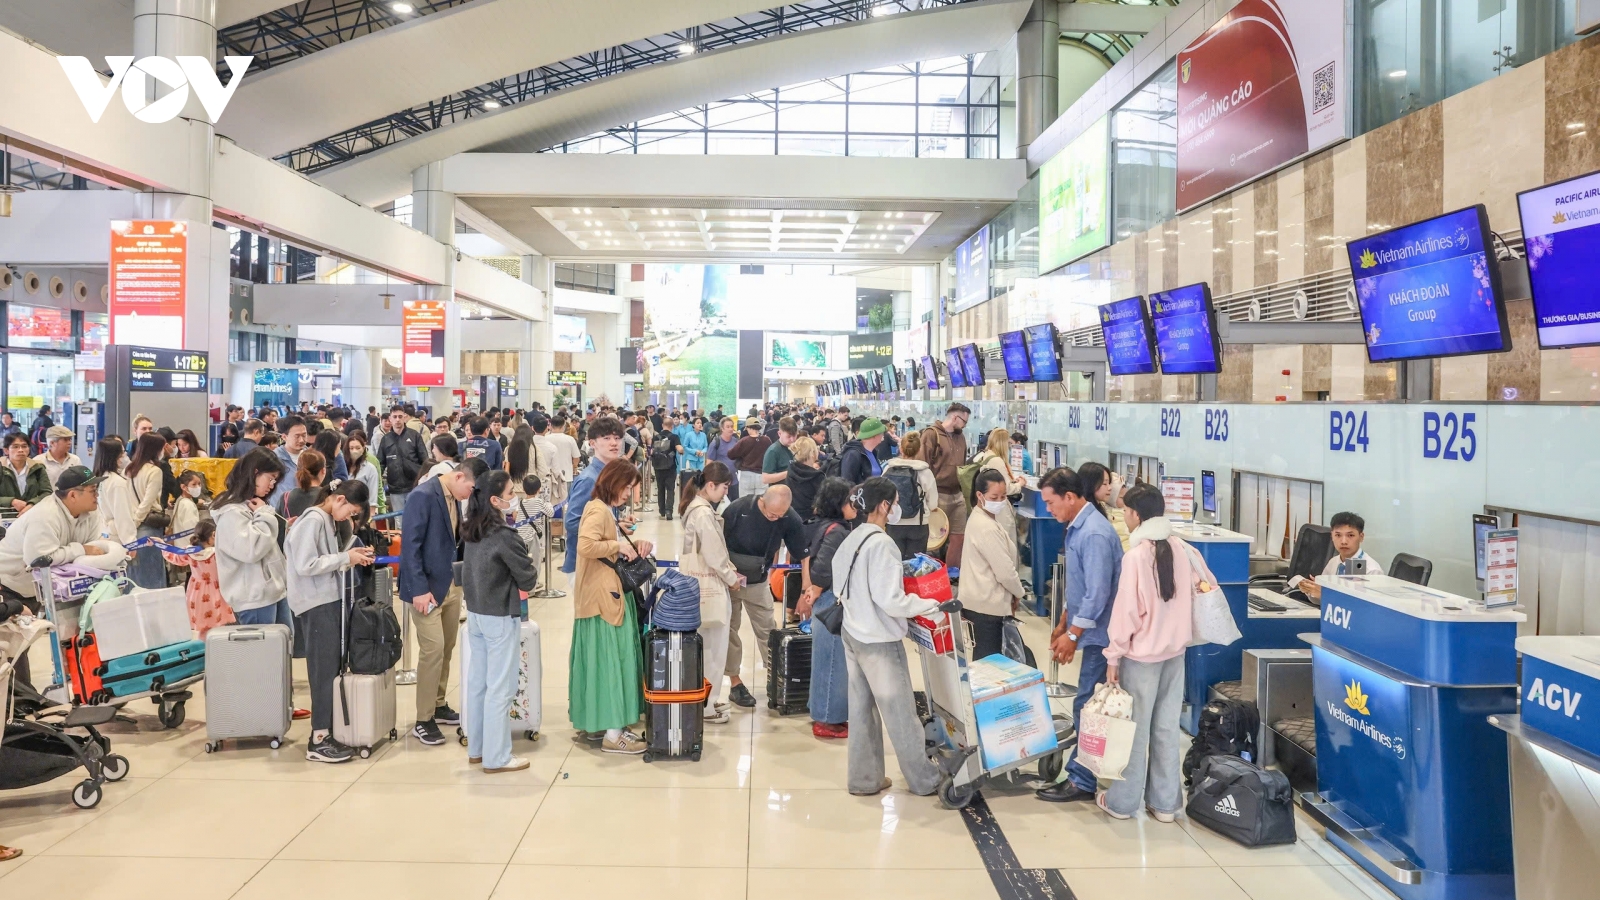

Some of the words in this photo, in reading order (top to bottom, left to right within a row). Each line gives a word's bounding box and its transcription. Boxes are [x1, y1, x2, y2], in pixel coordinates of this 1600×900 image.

[1197, 99, 1230, 129] QUẢNG
[1231, 80, 1252, 106] CÁO
[1555, 192, 1583, 206] PACIFIC
[1566, 208, 1599, 221] Vietnam
[1375, 245, 1415, 265] Vietnam
[1415, 236, 1454, 256] Airlines
[1389, 288, 1420, 306] KHÁCH
[1420, 282, 1450, 301] ĐOÀN
[1408, 309, 1436, 322] Group
[174, 355, 191, 370] 1-17
[1069, 406, 1081, 428] B20
[1095, 407, 1108, 431] B21
[1161, 408, 1181, 437] B22
[1205, 408, 1229, 442] B23
[1330, 410, 1369, 453] B24
[1423, 411, 1476, 462] B25
[1324, 603, 1351, 630] ACV
[1527, 678, 1582, 719] ACV
[1327, 700, 1360, 731] Vietnam
[1360, 719, 1392, 749] Airlines
[1214, 804, 1241, 817] adidas
